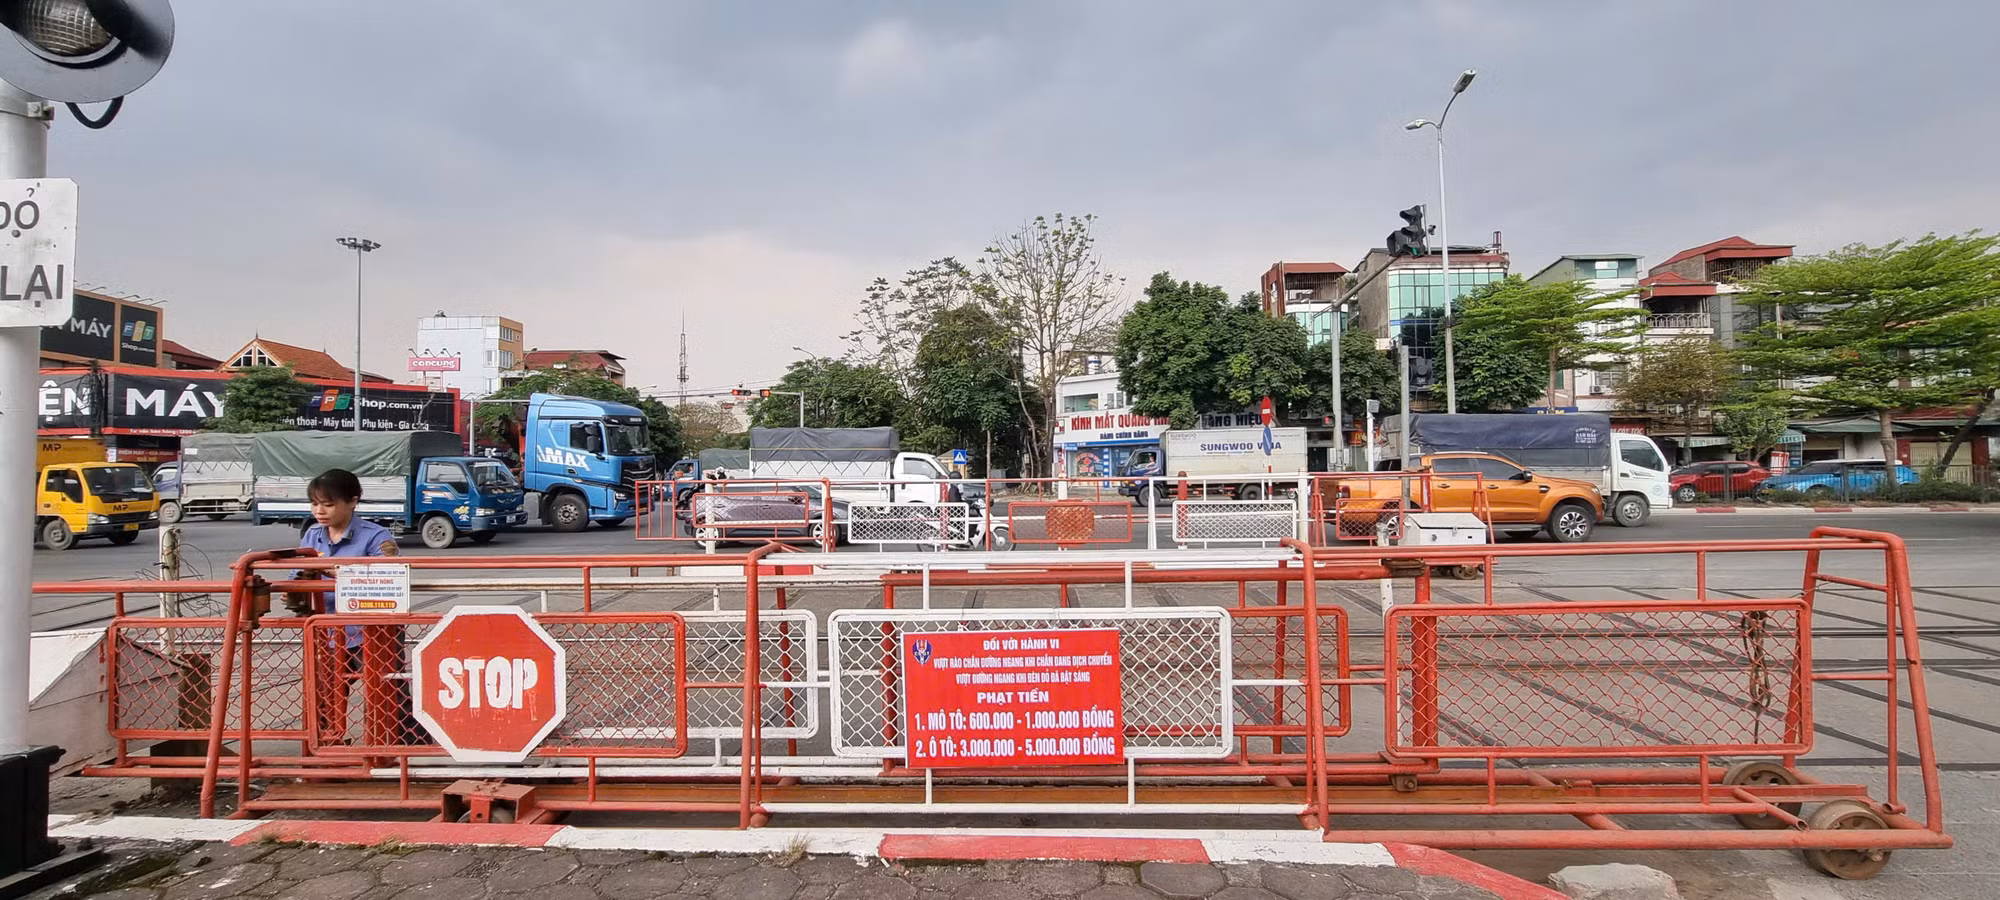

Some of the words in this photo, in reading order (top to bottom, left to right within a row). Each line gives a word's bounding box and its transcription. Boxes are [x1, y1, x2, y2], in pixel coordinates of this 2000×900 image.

[0, 264, 64, 308] LẠI
[71, 317, 112, 339] MÁY
[38, 380, 92, 422] ỆN
[126, 383, 225, 418] MÁY
[354, 397, 423, 410] hop.com.vn
[296, 416, 318, 428] thoại
[323, 417, 339, 429] Máy
[1071, 415, 1092, 430] KÍNH
[1095, 411, 1115, 429] MẮT
[43, 443, 61, 452] MP
[1200, 443, 1253, 451] SUNGWOO
[1257, 442, 1282, 450] VA
[545, 448, 590, 471] MAX
[113, 504, 128, 512] MP
[983, 636, 1000, 651] ĐỐI
[1002, 637, 1018, 651] VỚI
[1021, 637, 1048, 650] HÀNH
[1050, 638, 1060, 649] VI
[1002, 657, 1024, 668] NGANG
[1025, 656, 1036, 667] KHI
[438, 656, 538, 710] STOP
[994, 673, 1015, 685] NGANG
[1016, 673, 1027, 684] KHI
[1073, 670, 1091, 683] SÁNG
[977, 691, 1013, 705] PHẠT
[915, 713, 926, 731] 1.
[928, 709, 946, 730] MÔ
[949, 709, 967, 730] TÔ:
[969, 711, 1014, 730] 600.000
[1025, 711, 1080, 729] 1.000.000
[915, 739, 927, 758] 2.
[929, 736, 938, 757] Ô
[940, 736, 957, 757] TÔ:
[959, 738, 1015, 757] 3.000.000
[1025, 738, 1081, 756] 5.000.000
